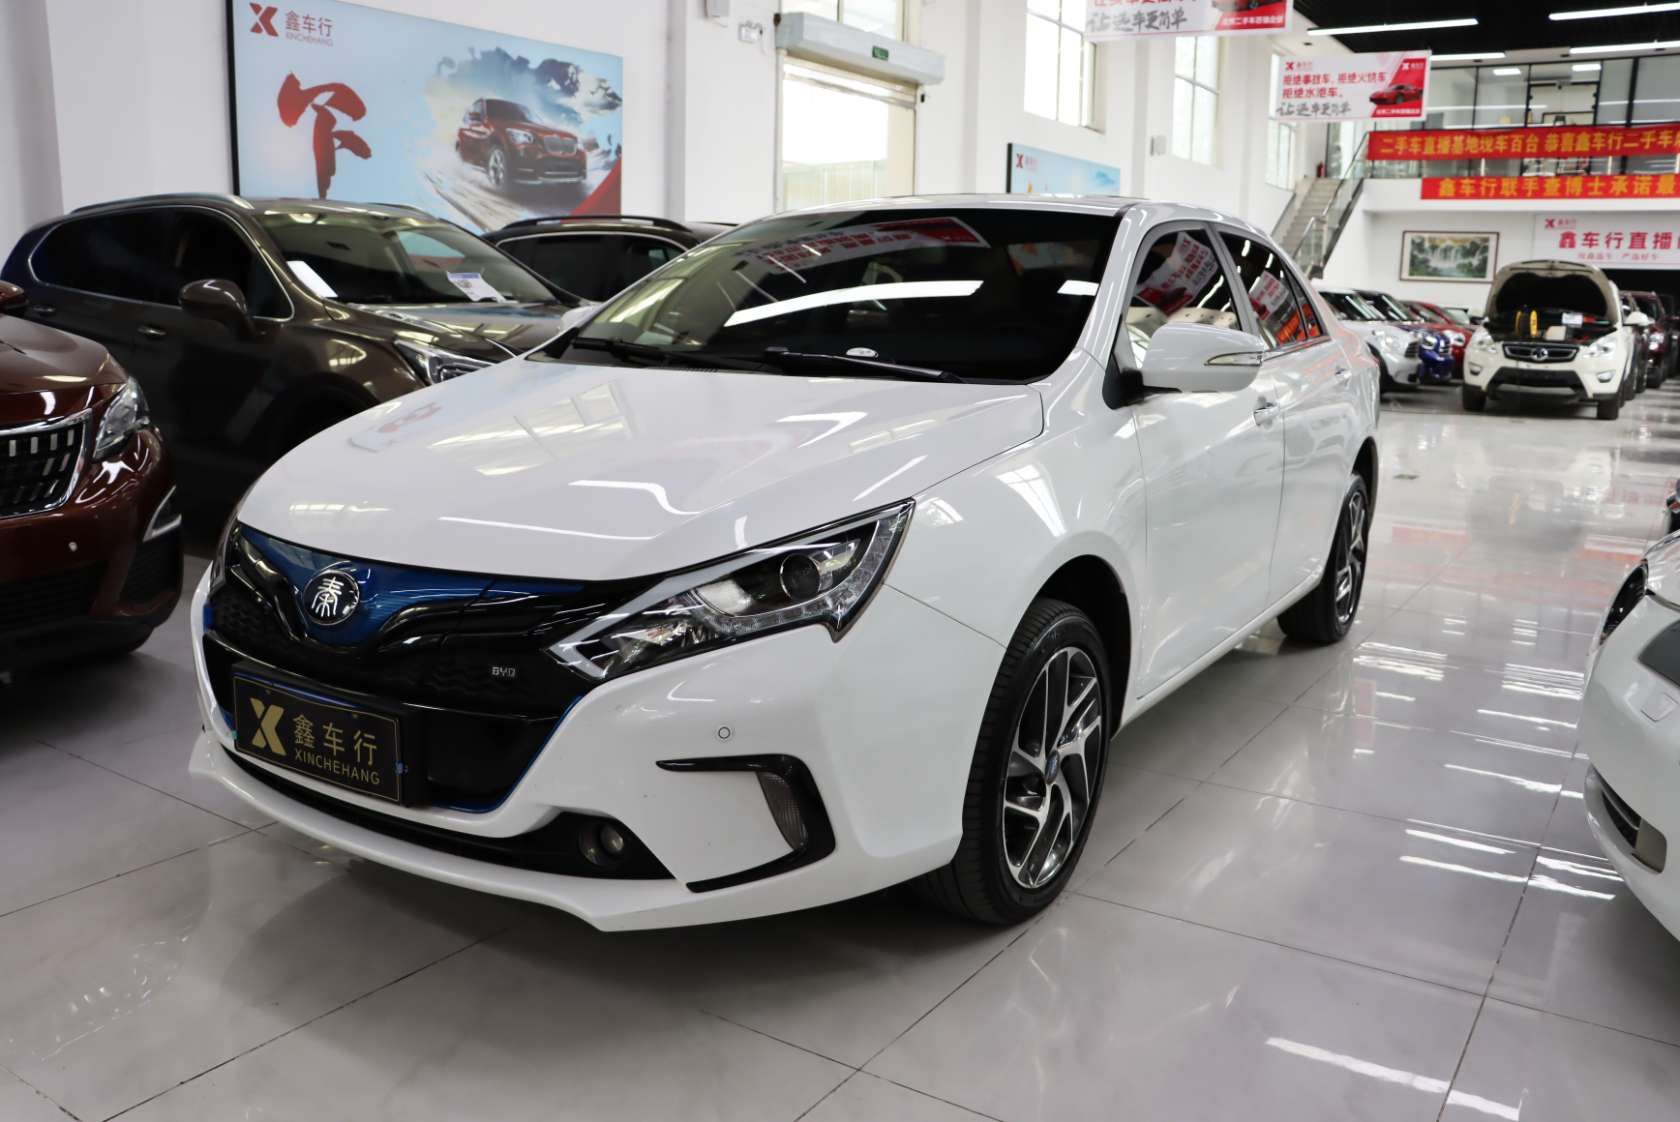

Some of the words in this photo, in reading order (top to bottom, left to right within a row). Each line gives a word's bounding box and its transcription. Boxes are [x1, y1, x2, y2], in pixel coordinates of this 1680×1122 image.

[285, 10, 333, 37] 鑫车行
[1558, 231, 1680, 250] 鑫车行直播
[491, 666, 516, 678] BYD
[292, 714, 378, 766] 鑫车行
[294, 747, 381, 785] XINCHEHANG
